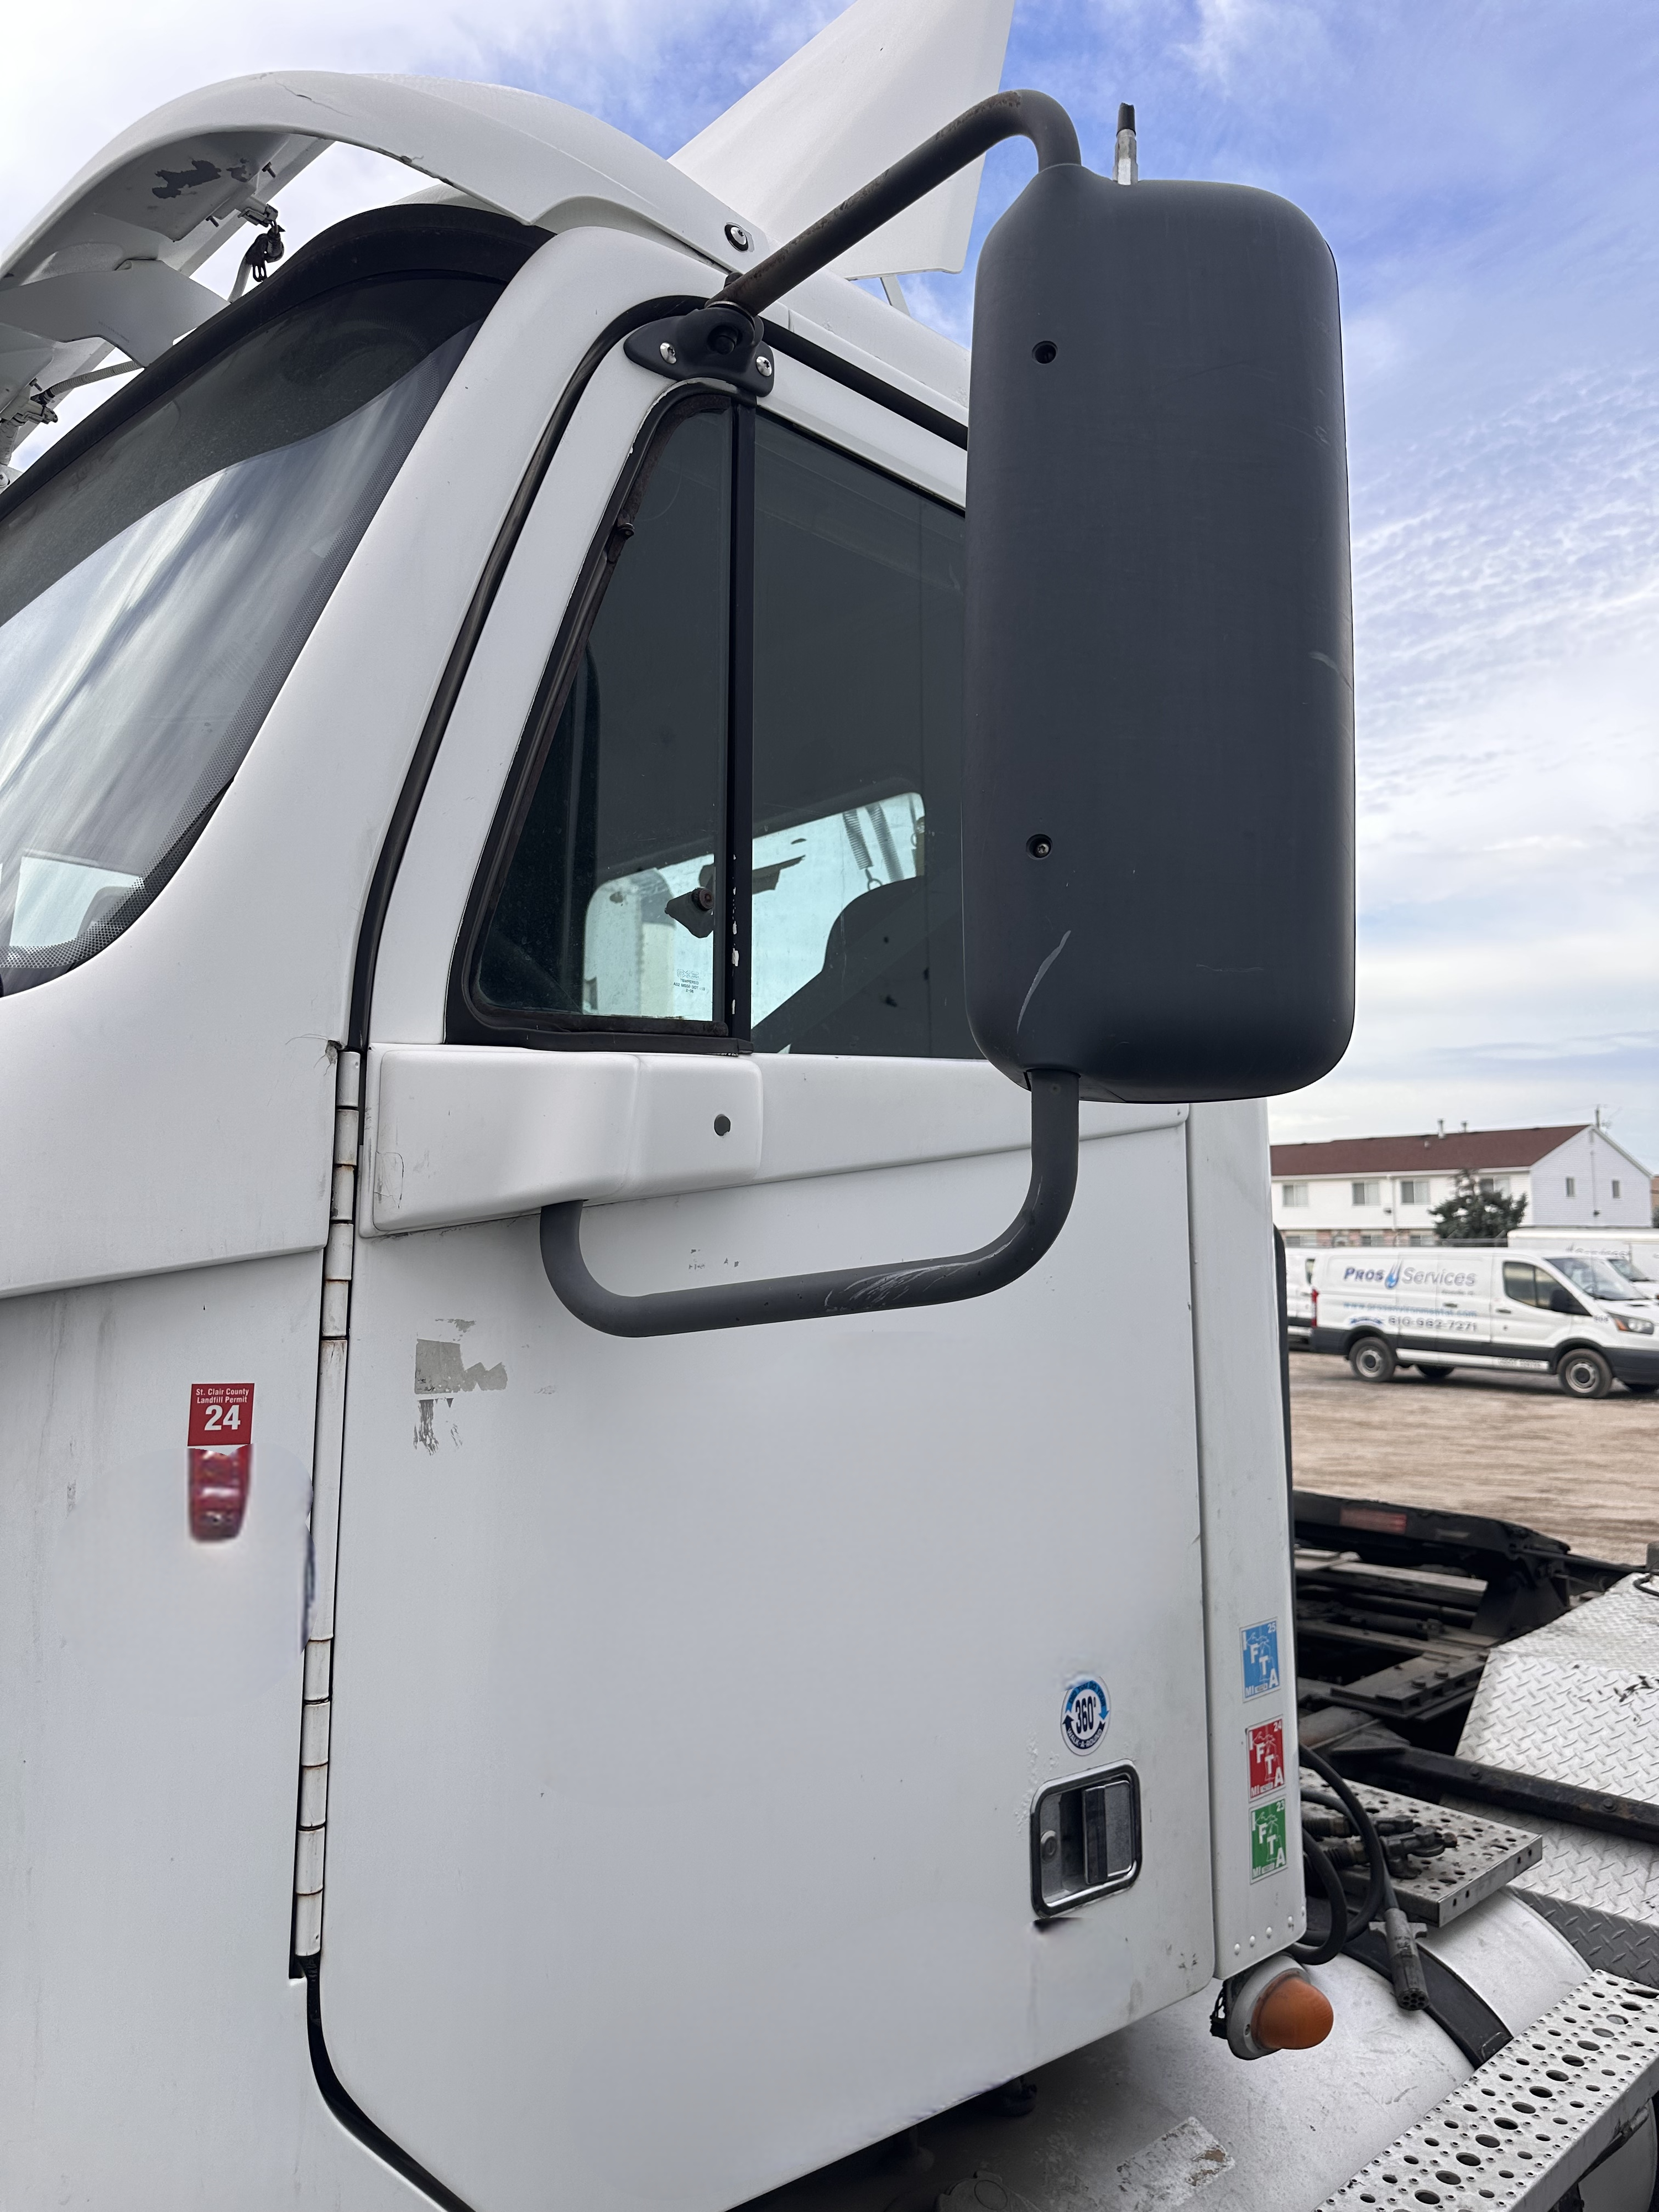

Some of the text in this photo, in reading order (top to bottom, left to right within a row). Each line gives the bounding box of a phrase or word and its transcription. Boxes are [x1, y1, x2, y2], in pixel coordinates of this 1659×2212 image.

[1402, 1266, 1477, 1287] Services
[226, 1388, 249, 1396] County
[197, 1396, 223, 1404] Landfill
[204, 1405, 241, 1431] 24
[1267, 1622, 1276, 1634] 25
[1245, 1685, 1254, 1698] MI
[1273, 1720, 1282, 1733] 24
[1276, 1799, 1285, 1812] 23
